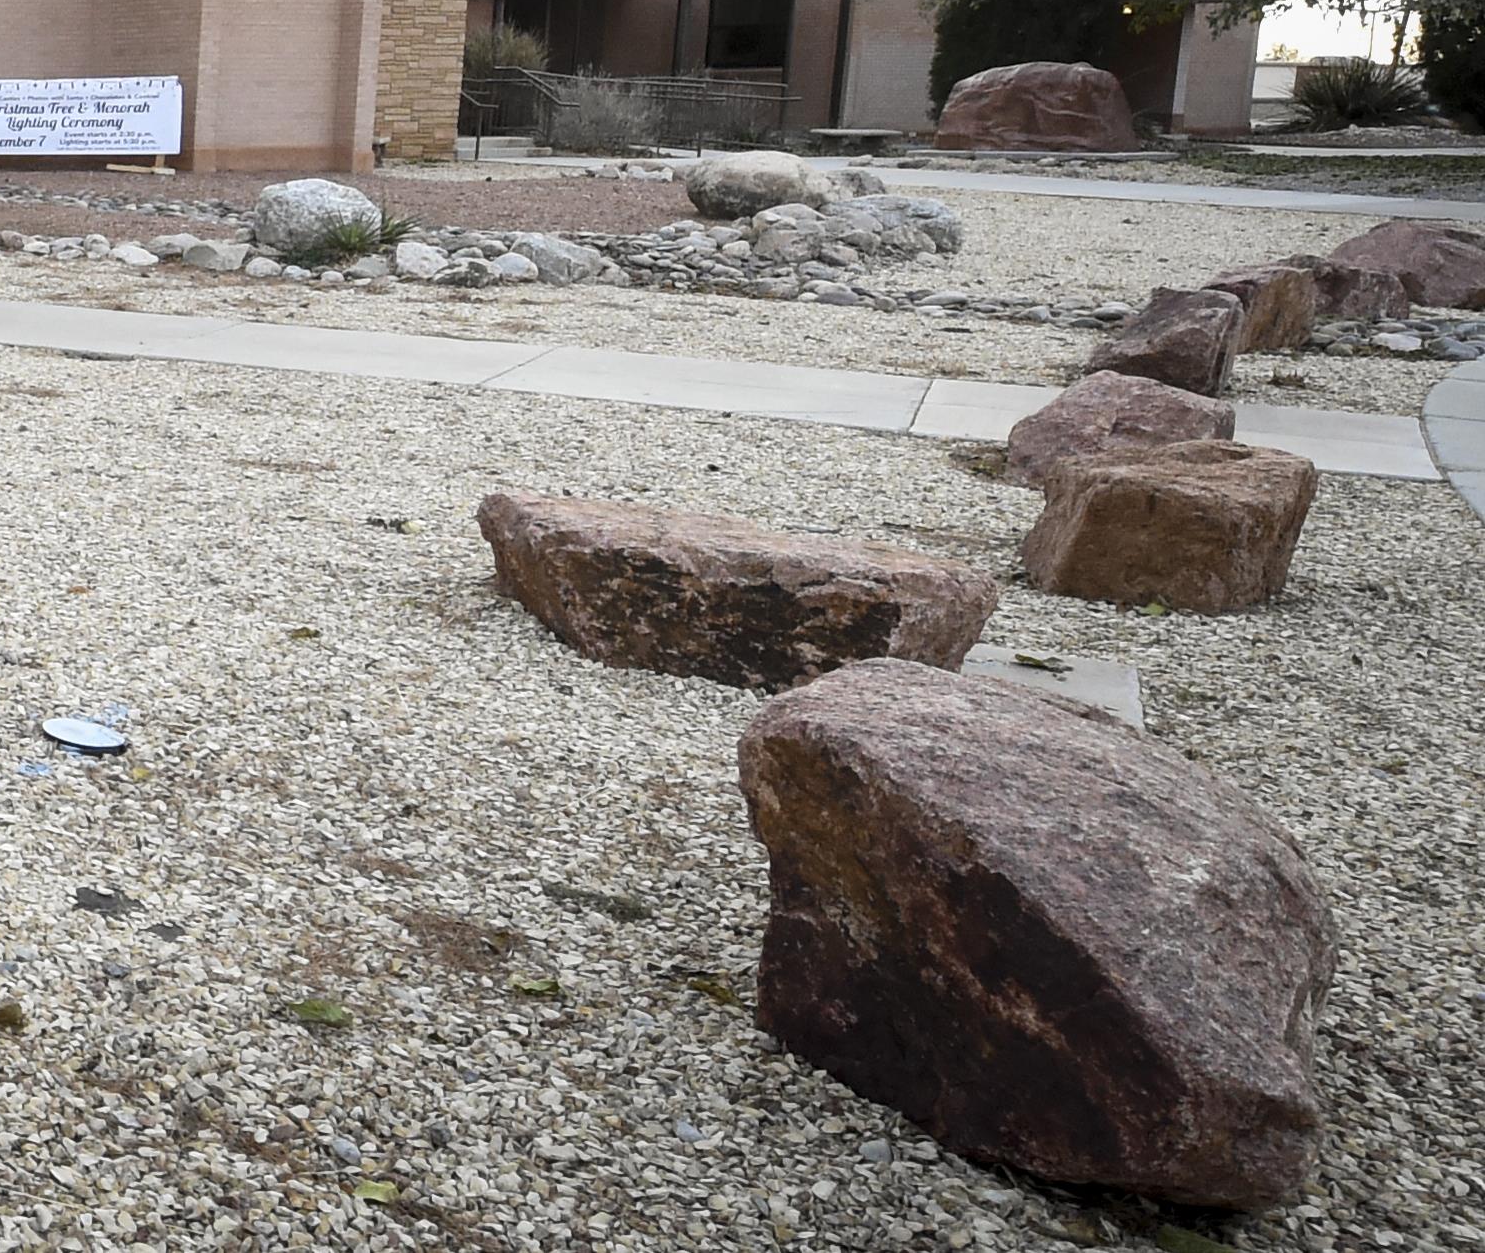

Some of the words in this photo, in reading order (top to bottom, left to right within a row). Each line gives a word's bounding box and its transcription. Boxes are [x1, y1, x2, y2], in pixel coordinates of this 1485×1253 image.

[48, 101, 75, 114] Tree
[77, 101, 89, 114] &
[93, 101, 150, 114] Menorah
[6, 117, 57, 132] Lighting
[60, 116, 124, 130] Ceremony
[38, 135, 47, 147] 7
